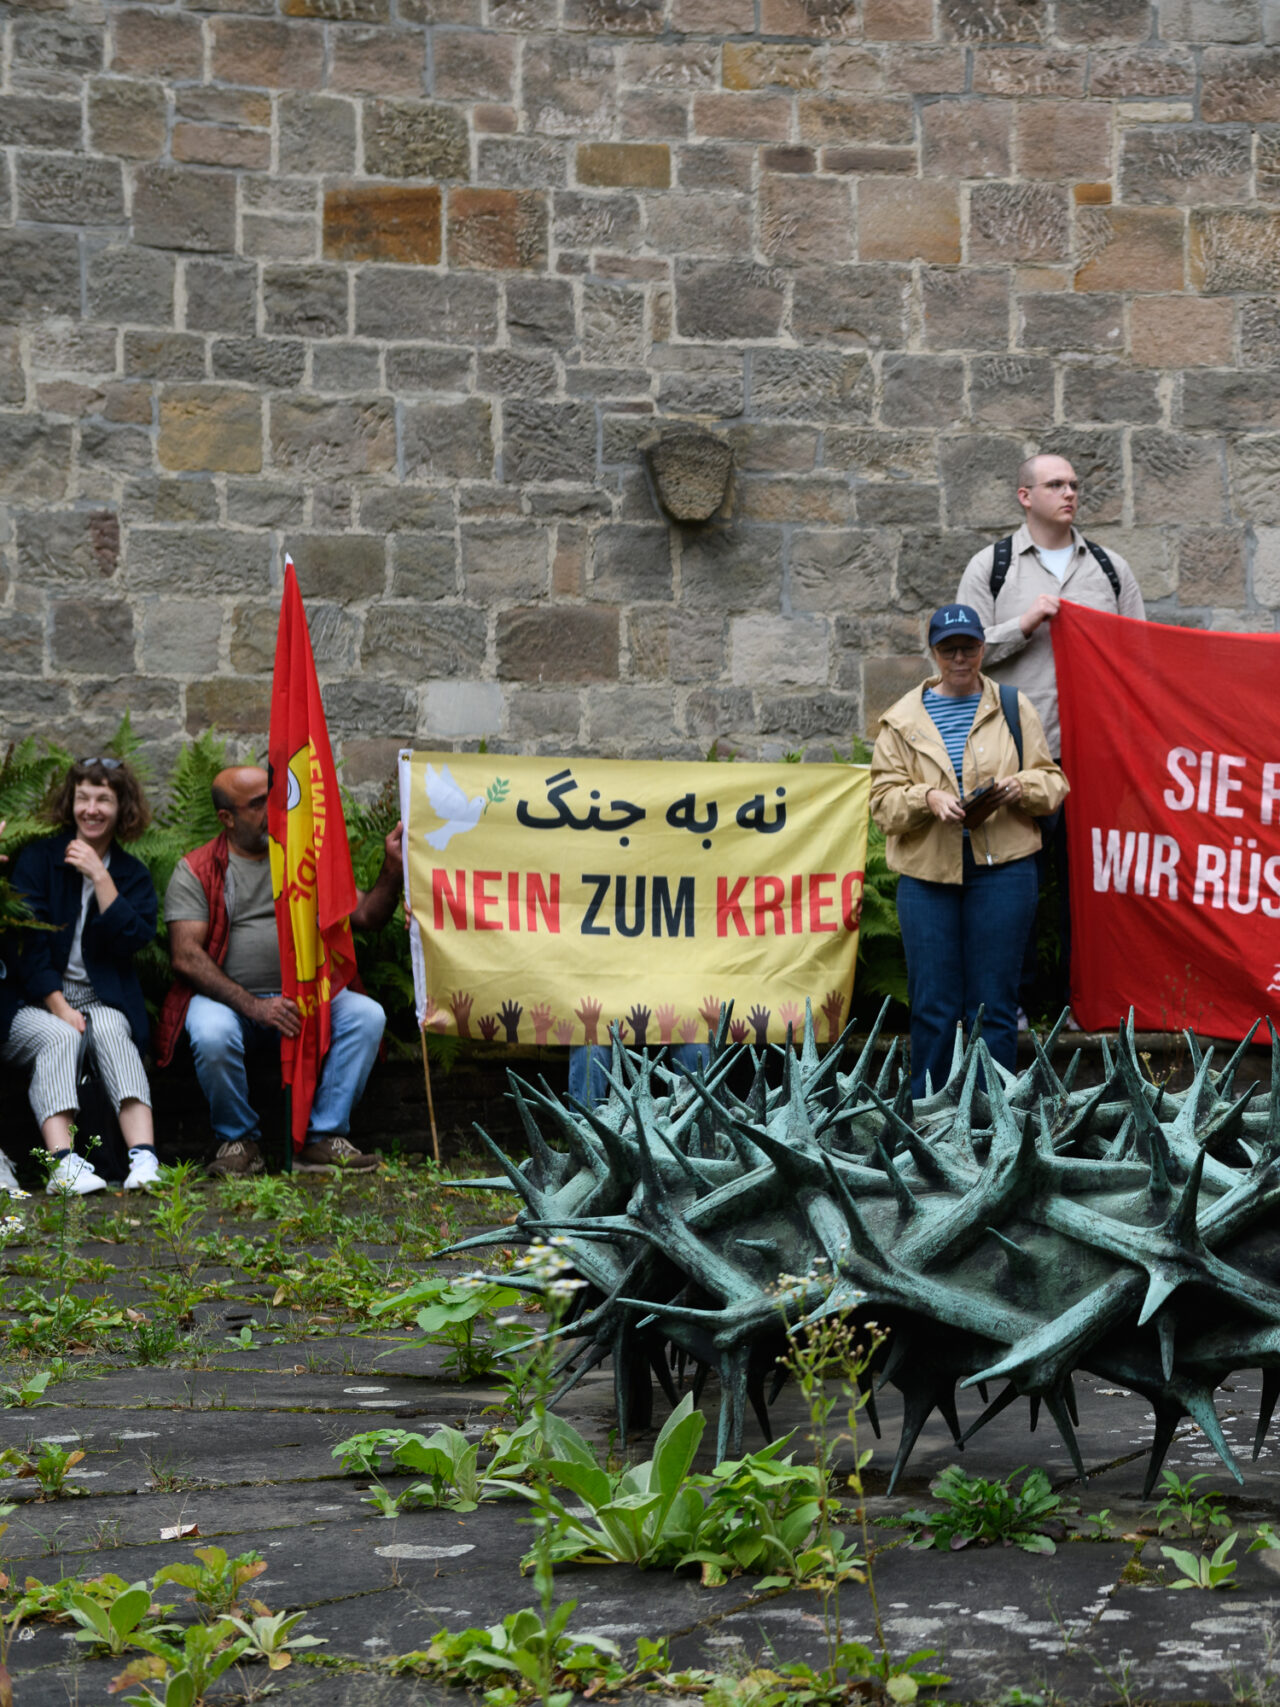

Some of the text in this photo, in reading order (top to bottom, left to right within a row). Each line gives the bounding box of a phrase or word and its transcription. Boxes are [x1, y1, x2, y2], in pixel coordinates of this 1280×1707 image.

[516, 768, 787, 850] نه به جنگ
[1163, 746, 1246, 818] SIE
[1091, 827, 1181, 901] WIR
[431, 868, 561, 934] NEIN
[580, 874, 696, 938] ZUM
